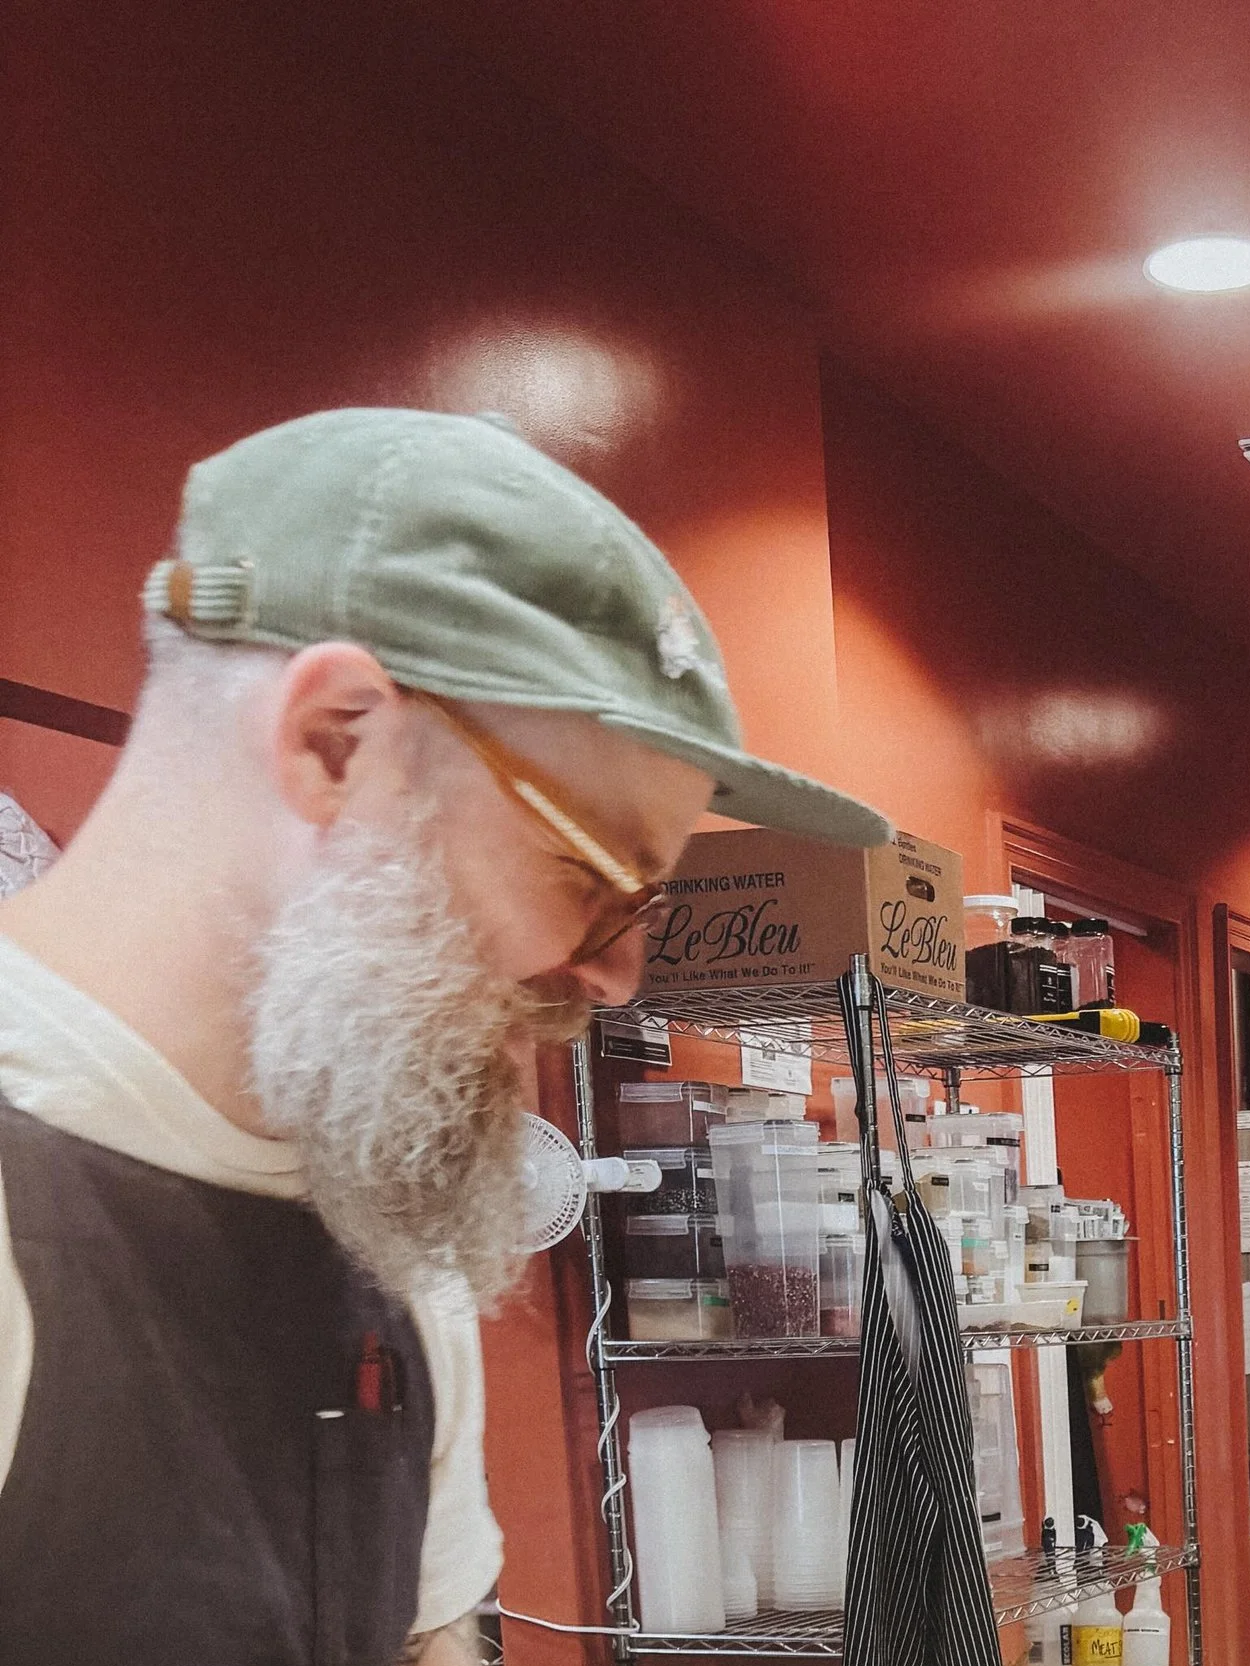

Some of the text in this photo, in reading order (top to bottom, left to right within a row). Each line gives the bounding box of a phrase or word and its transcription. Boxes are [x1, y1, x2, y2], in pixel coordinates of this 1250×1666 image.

[734, 872, 785, 890] WATER
[683, 969, 707, 983] Like
[709, 967, 738, 980] What
[742, 966, 760, 979] We
[763, 965, 779, 976] Do
[783, 964, 796, 975] To
